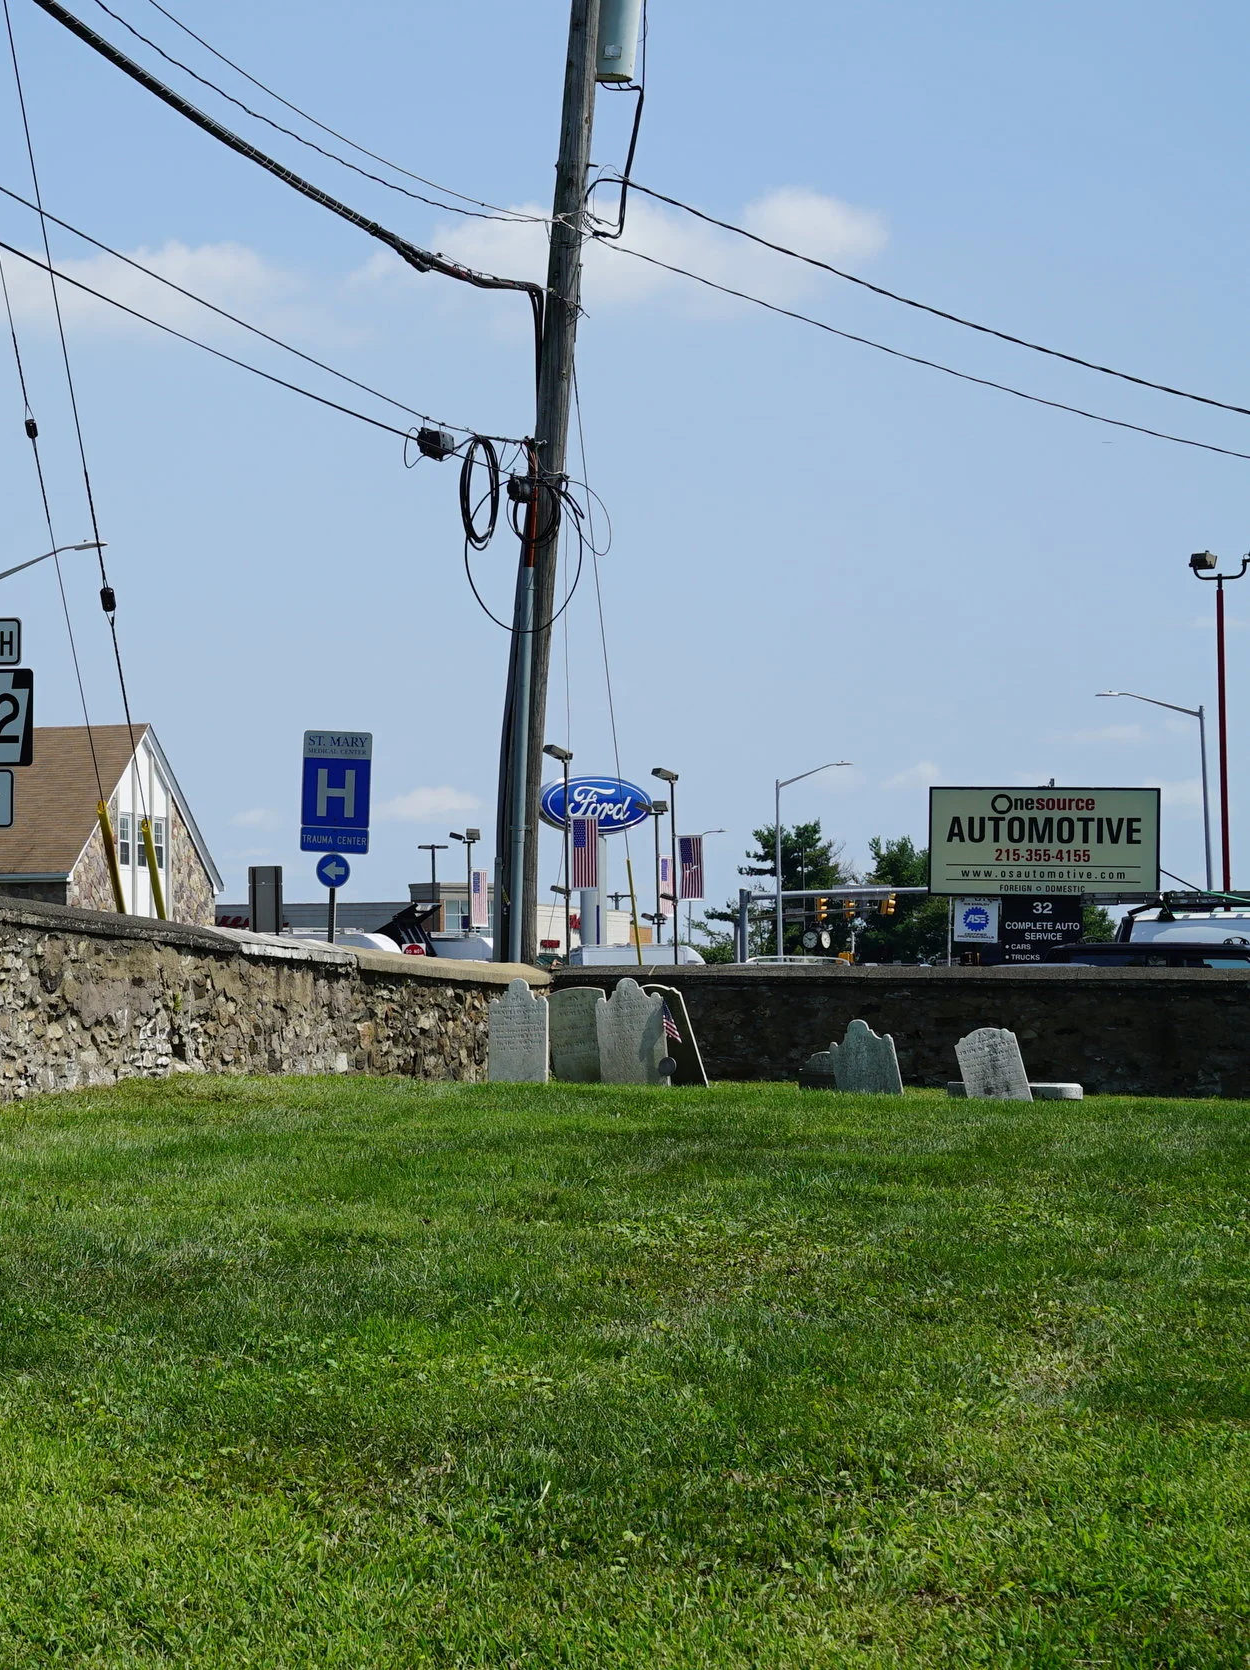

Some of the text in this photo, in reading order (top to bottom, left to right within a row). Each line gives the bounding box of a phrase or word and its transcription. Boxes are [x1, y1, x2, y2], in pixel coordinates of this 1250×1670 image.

[308, 736, 368, 747] ST. MARY
[316, 768, 356, 818] H
[569, 786, 631, 821] Ford
[946, 816, 1142, 844] AUTOMOTIVE
[302, 834, 367, 846] TRAUMA CENTER
[994, 849, 1090, 862] 215-355-4155
[961, 869, 1126, 880] www.osautomotive.com
[1045, 885, 1086, 893] DOMESTIC
[1032, 902, 1053, 914] 32
[966, 914, 986, 923] ASE
[1005, 922, 1080, 930] COMPLETE AUTO
[1024, 932, 1063, 940] SERVICE
